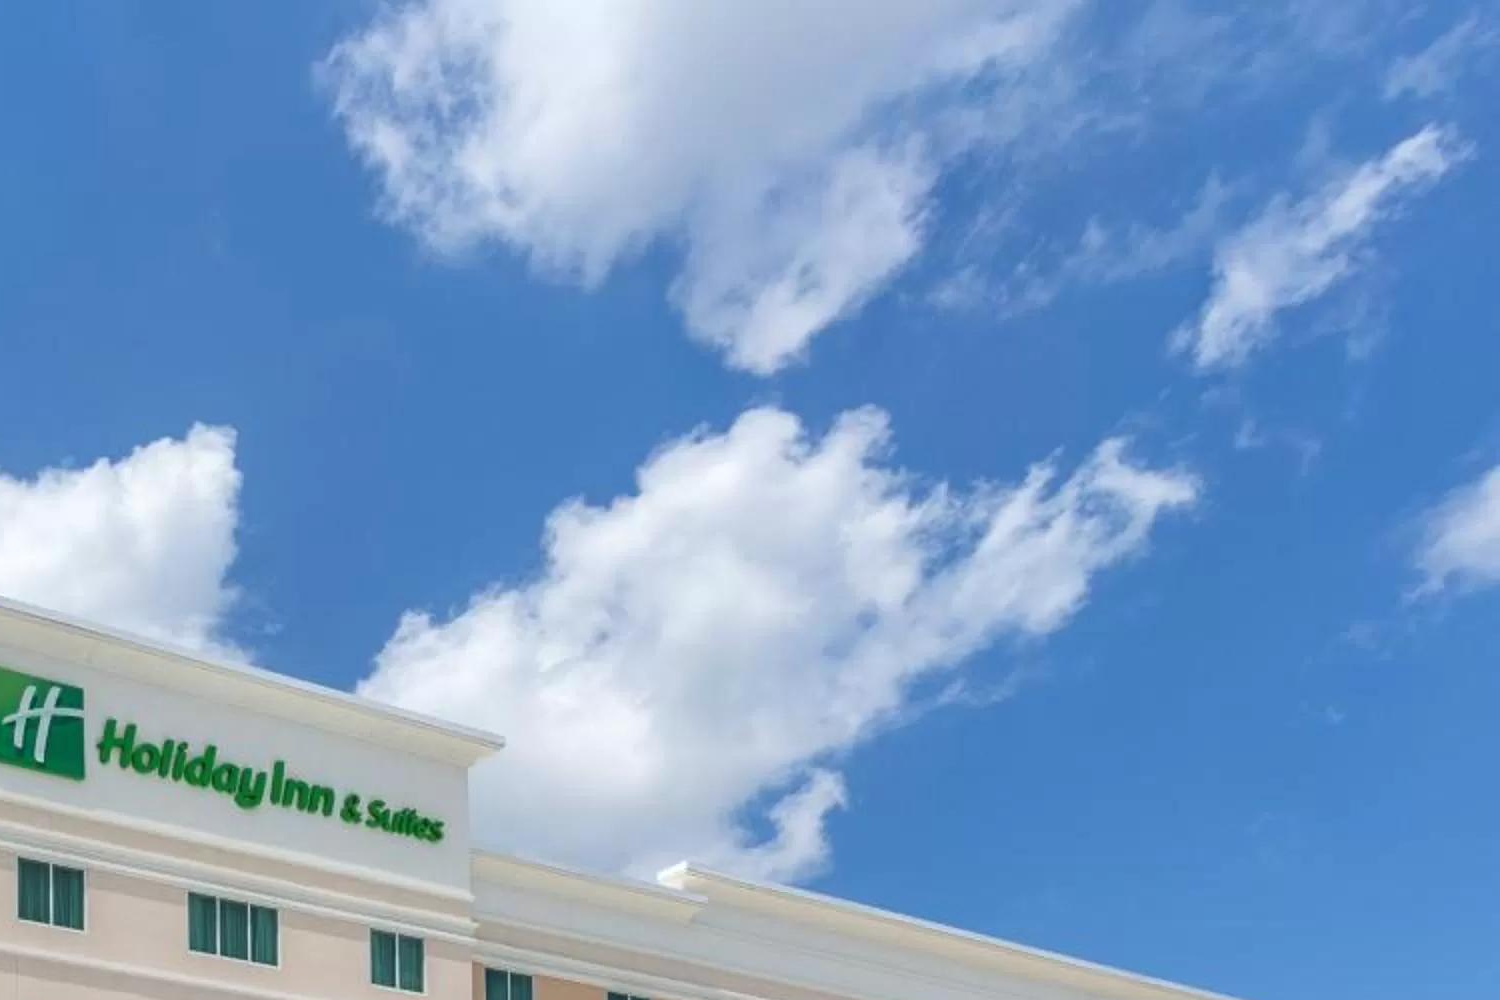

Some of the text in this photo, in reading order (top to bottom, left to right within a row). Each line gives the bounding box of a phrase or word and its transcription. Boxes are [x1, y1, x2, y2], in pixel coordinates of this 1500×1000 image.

[96, 718, 444, 842] Holiday Inn & Suites
